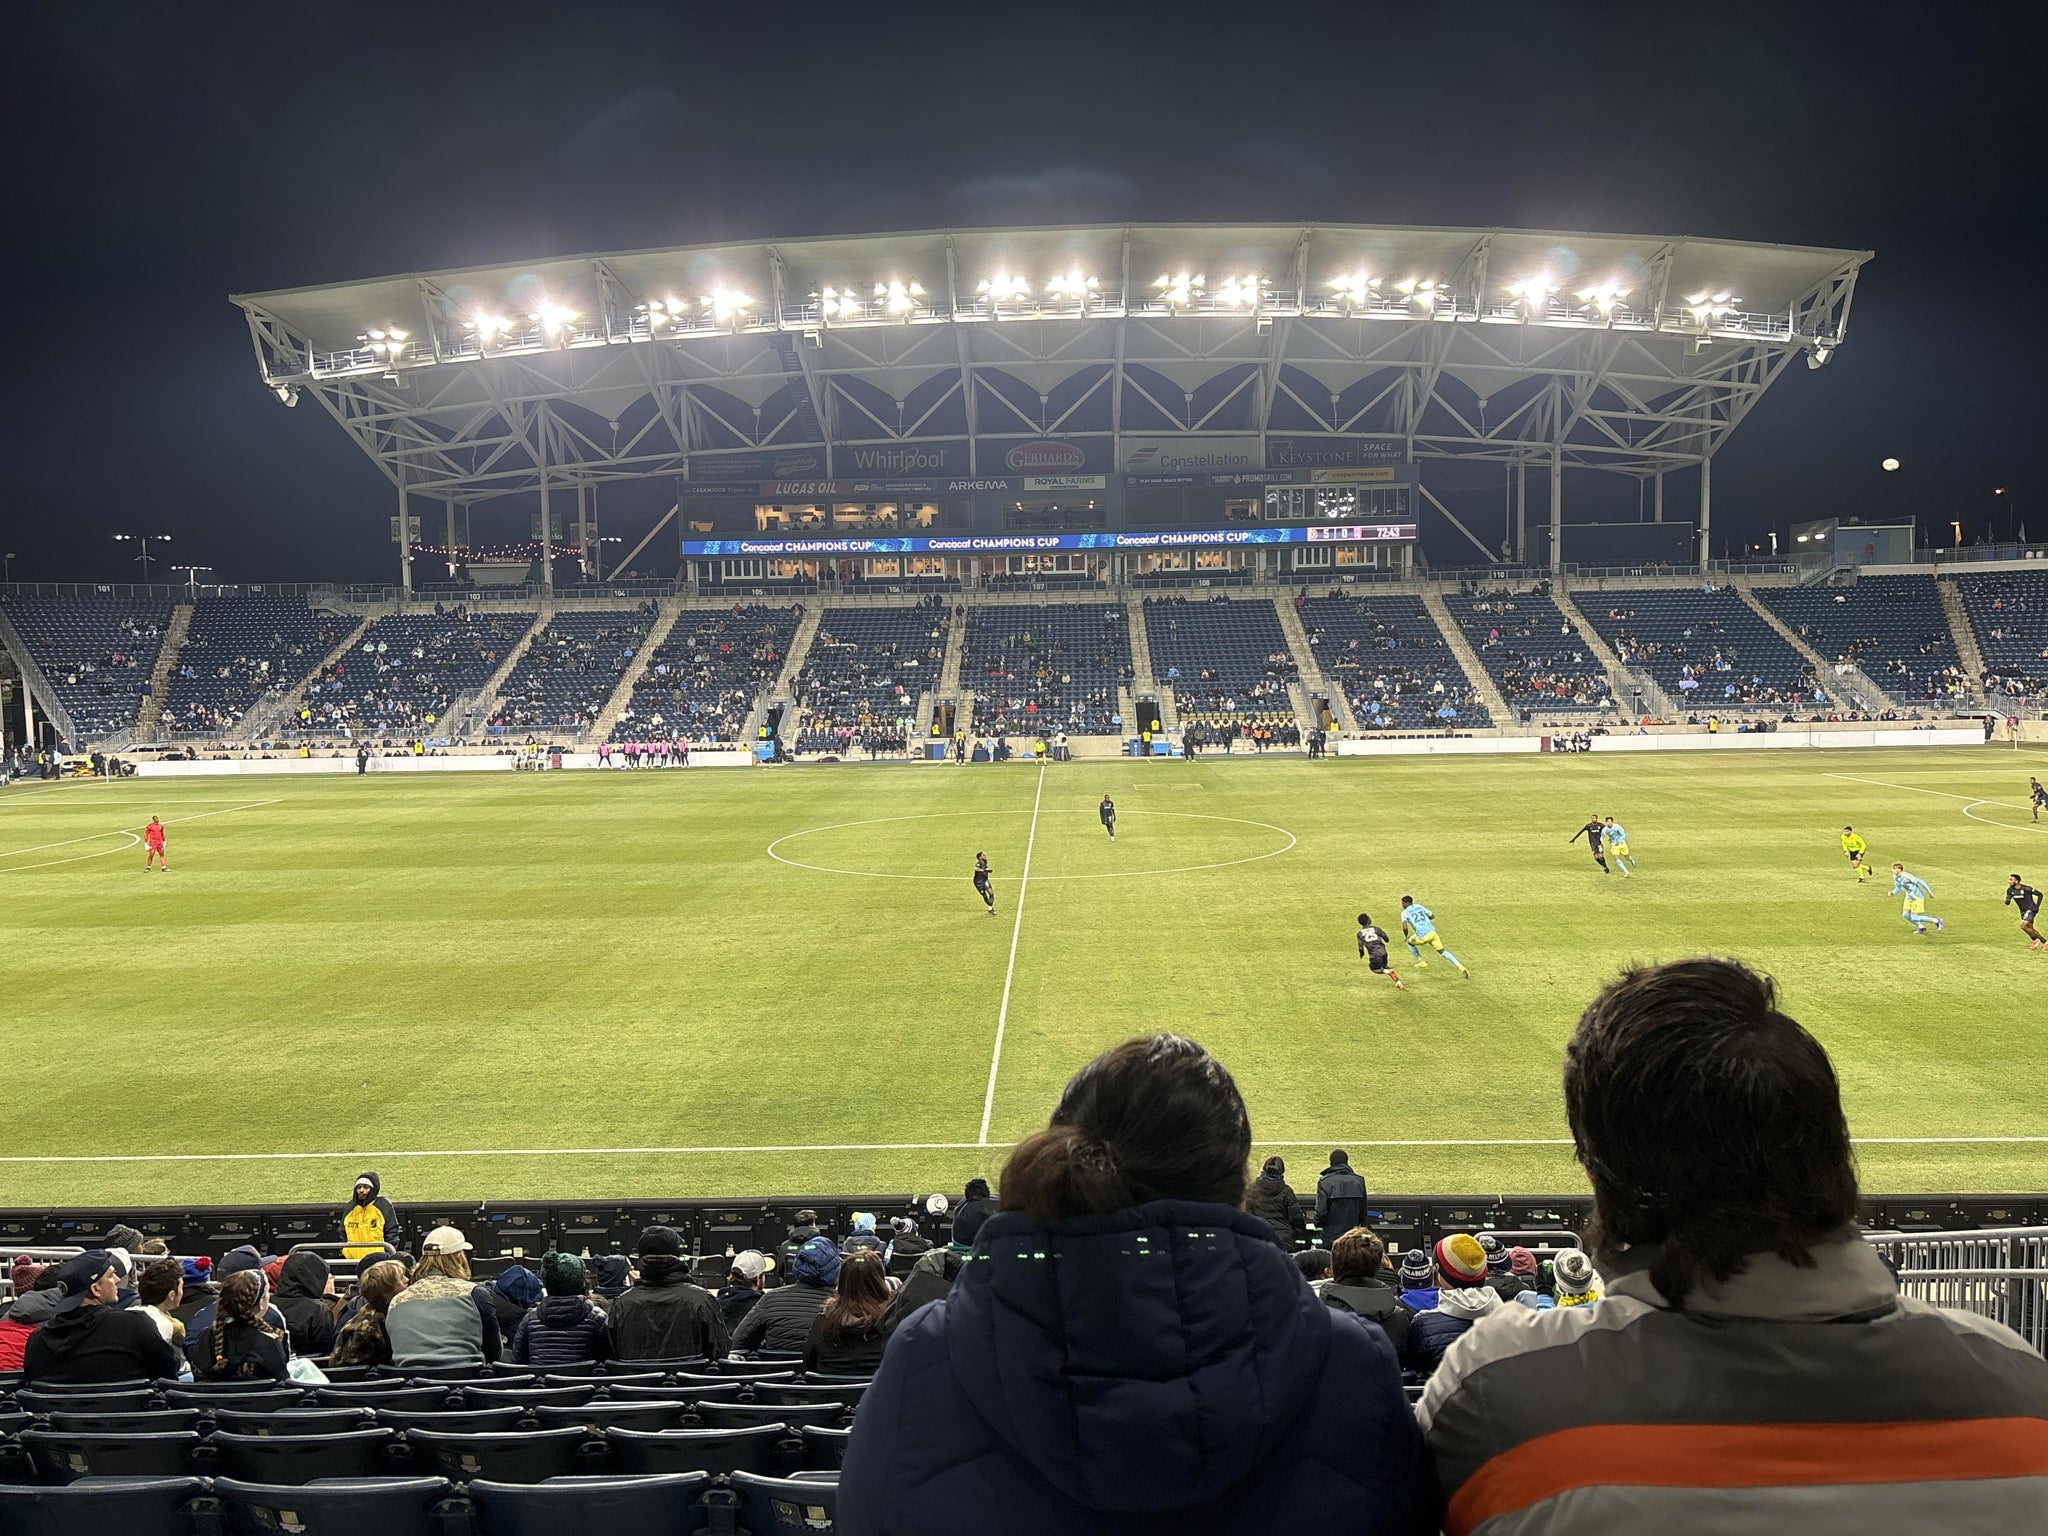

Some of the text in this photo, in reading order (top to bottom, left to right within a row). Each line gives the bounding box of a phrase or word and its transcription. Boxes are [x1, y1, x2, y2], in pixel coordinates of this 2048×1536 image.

[1363, 443, 1392, 451] SPACE
[1161, 453, 1248, 467] Constellation
[1280, 451, 1353, 463] KEYSTONE
[1380, 451, 1402, 459] WHAT
[854, 449, 944, 474] Whirlpool
[949, 480, 1008, 491] ARKEMA
[1034, 477, 1095, 486] ROYAL FARMS
[776, 482, 837, 494] LUCAS OIL
[1116, 532, 1249, 545] Concacaf CHAMPIONS CUP
[1323, 528, 1348, 538] 5 0
[741, 541, 872, 552] Concacaf CHAMPIONS CUP
[929, 537, 1060, 549] Concacaf CHAMPIONS CUP
[1492, 571, 1505, 579] 110
[97, 585, 111, 593] 101
[751, 588, 763, 596] 105
[1032, 583, 1045, 591] 107
[1411, 910, 1426, 923] 23
